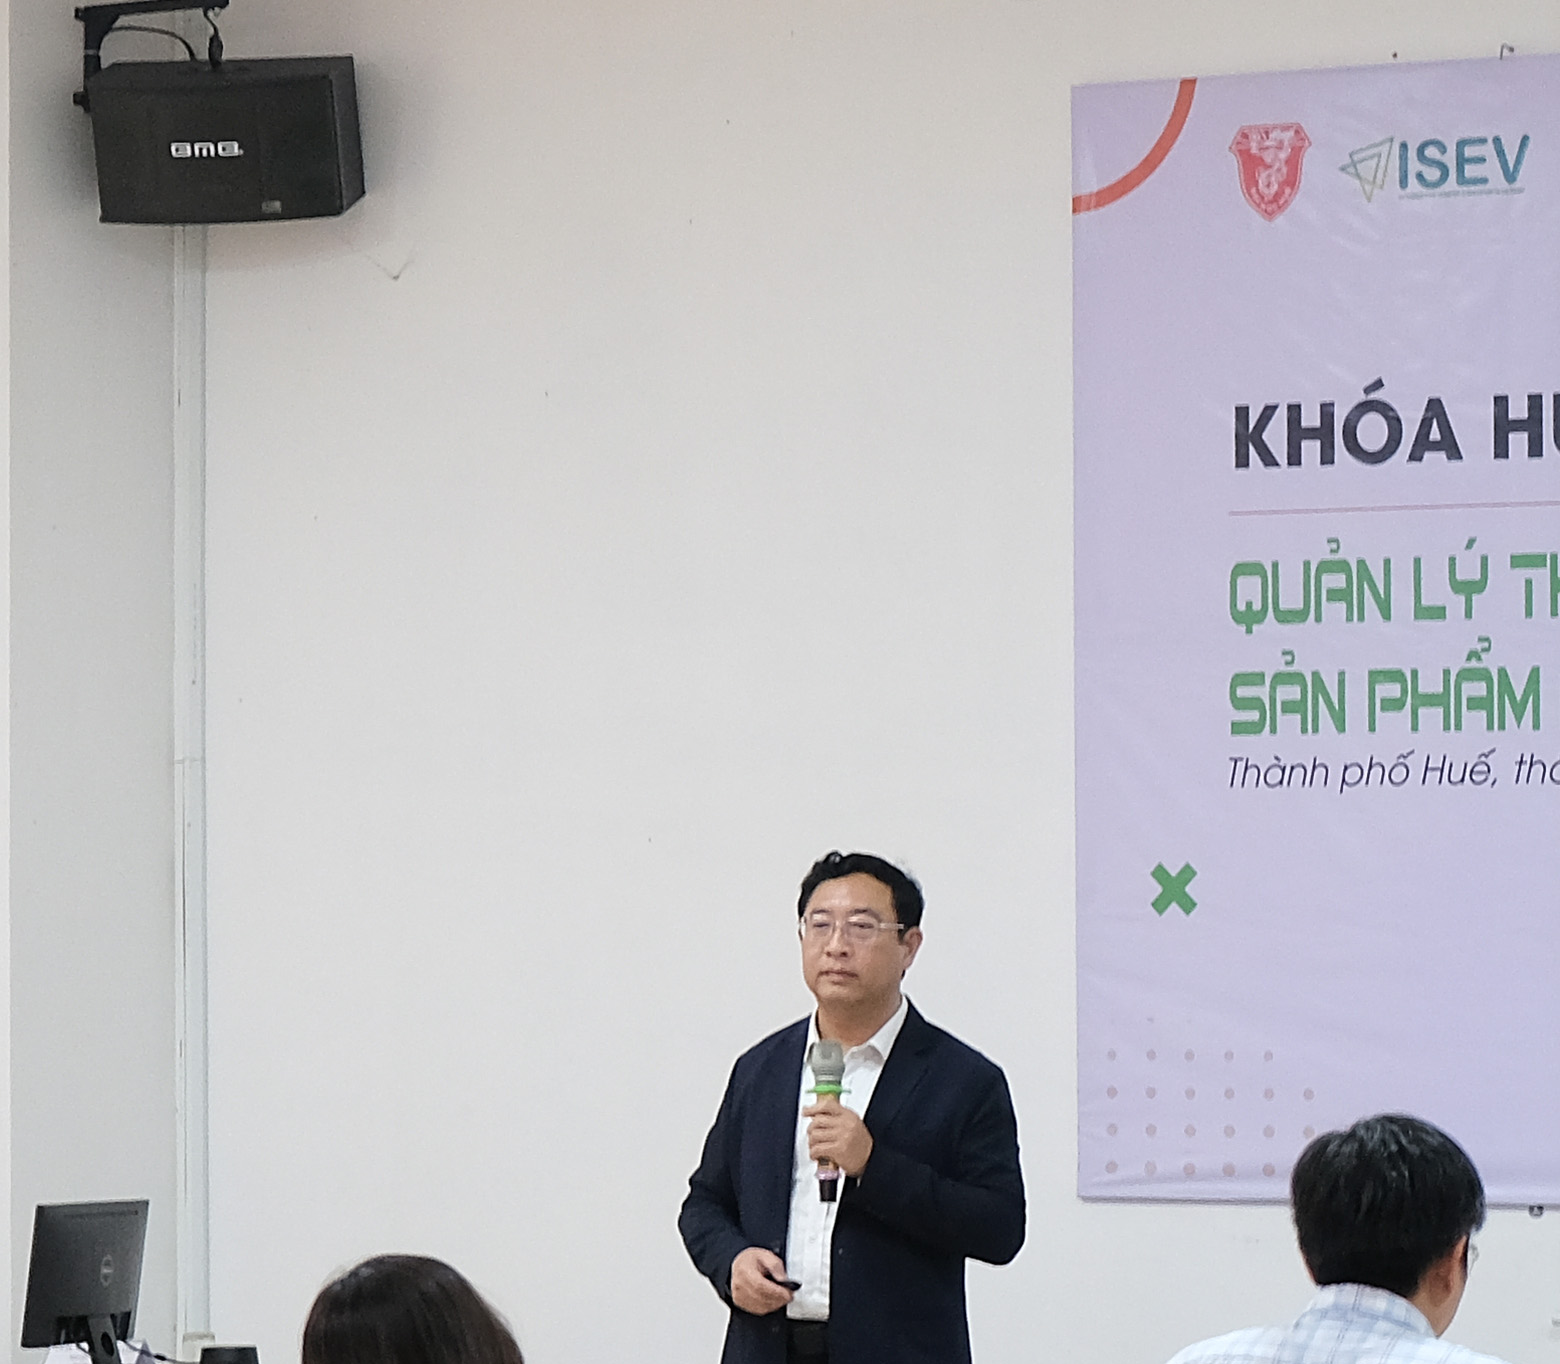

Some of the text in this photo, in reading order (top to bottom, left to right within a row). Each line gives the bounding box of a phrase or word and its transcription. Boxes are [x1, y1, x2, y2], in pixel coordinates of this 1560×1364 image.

[1398, 134, 1530, 189] ISEV
[1234, 376, 1464, 469] KHÓA
[1229, 537, 1392, 634] QUẢN
[1413, 536, 1489, 621] LÝ
[1229, 649, 1346, 737] SẢN
[1367, 635, 1541, 733] PHẨM
[1228, 753, 1329, 789] Thành
[1339, 749, 1417, 794] phố
[1421, 748, 1498, 788] Huế,
